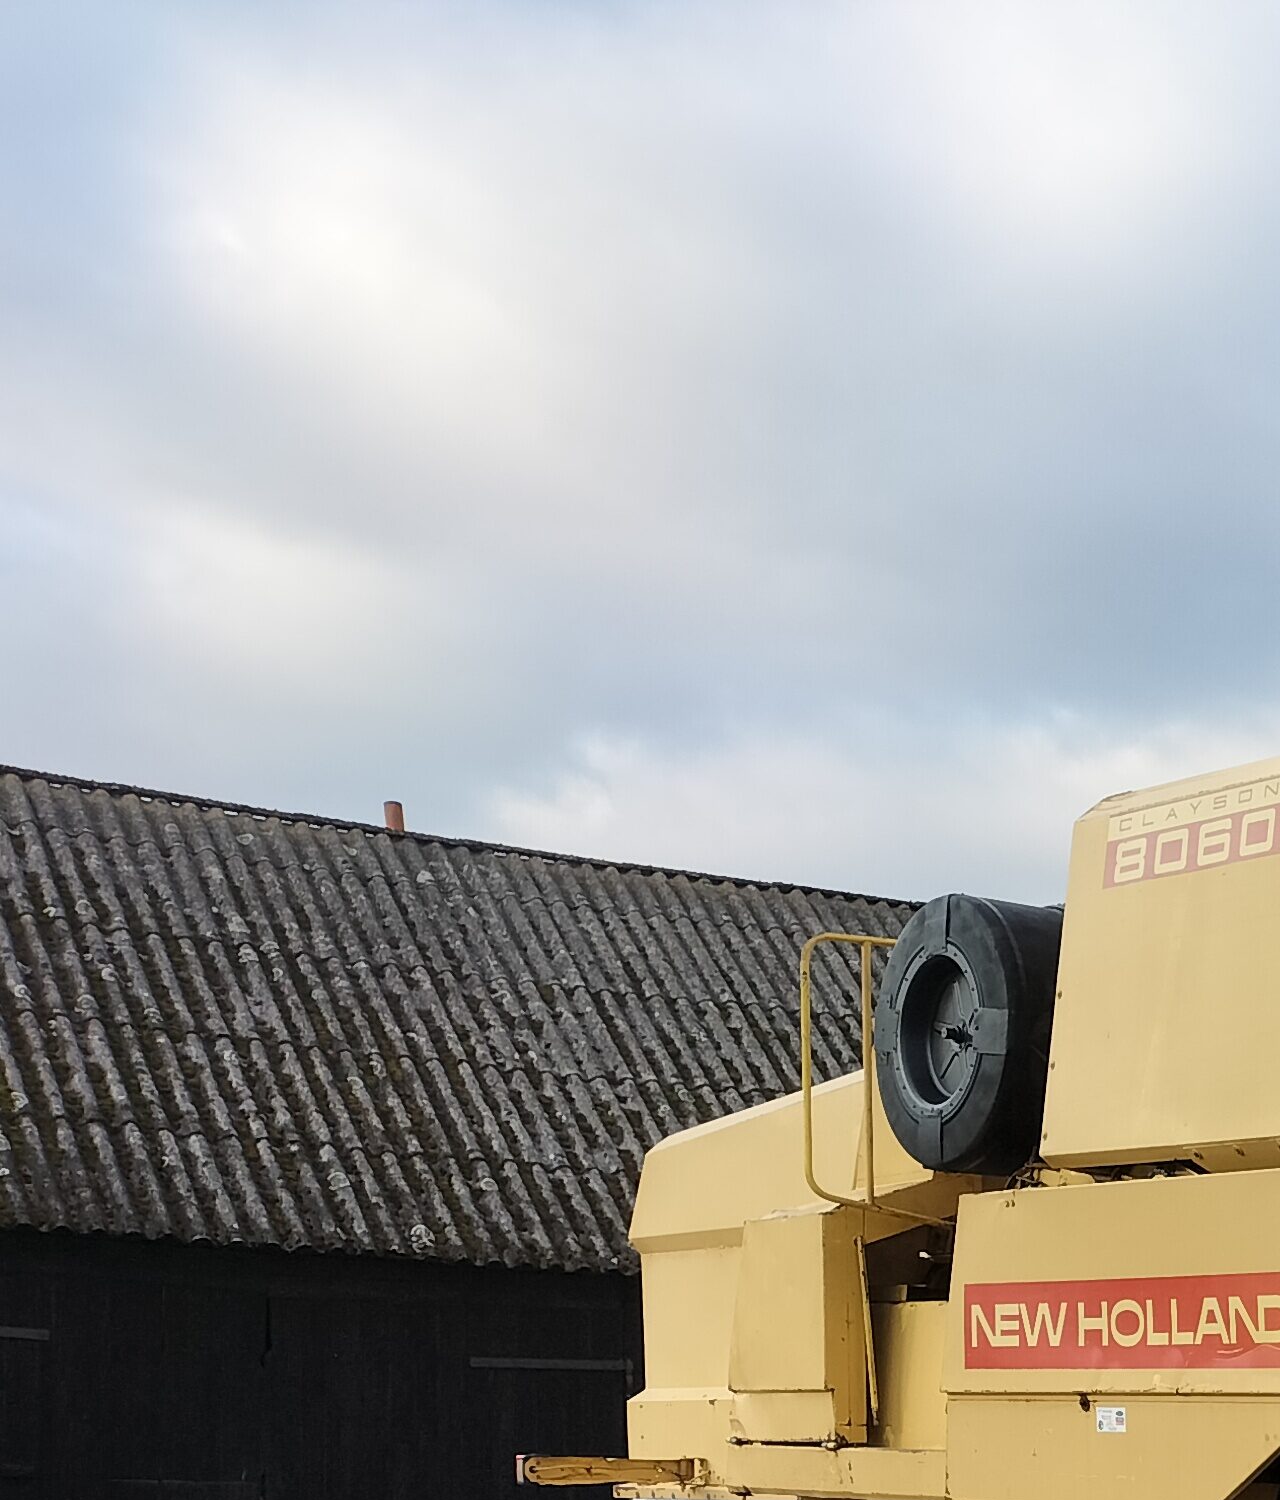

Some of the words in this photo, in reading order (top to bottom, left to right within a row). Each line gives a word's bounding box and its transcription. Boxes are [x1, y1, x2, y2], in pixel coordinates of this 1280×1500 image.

[1118, 782, 1280, 832] CLAYSON
[1113, 807, 1277, 885] 8060
[970, 1302, 1068, 1348] NEW
